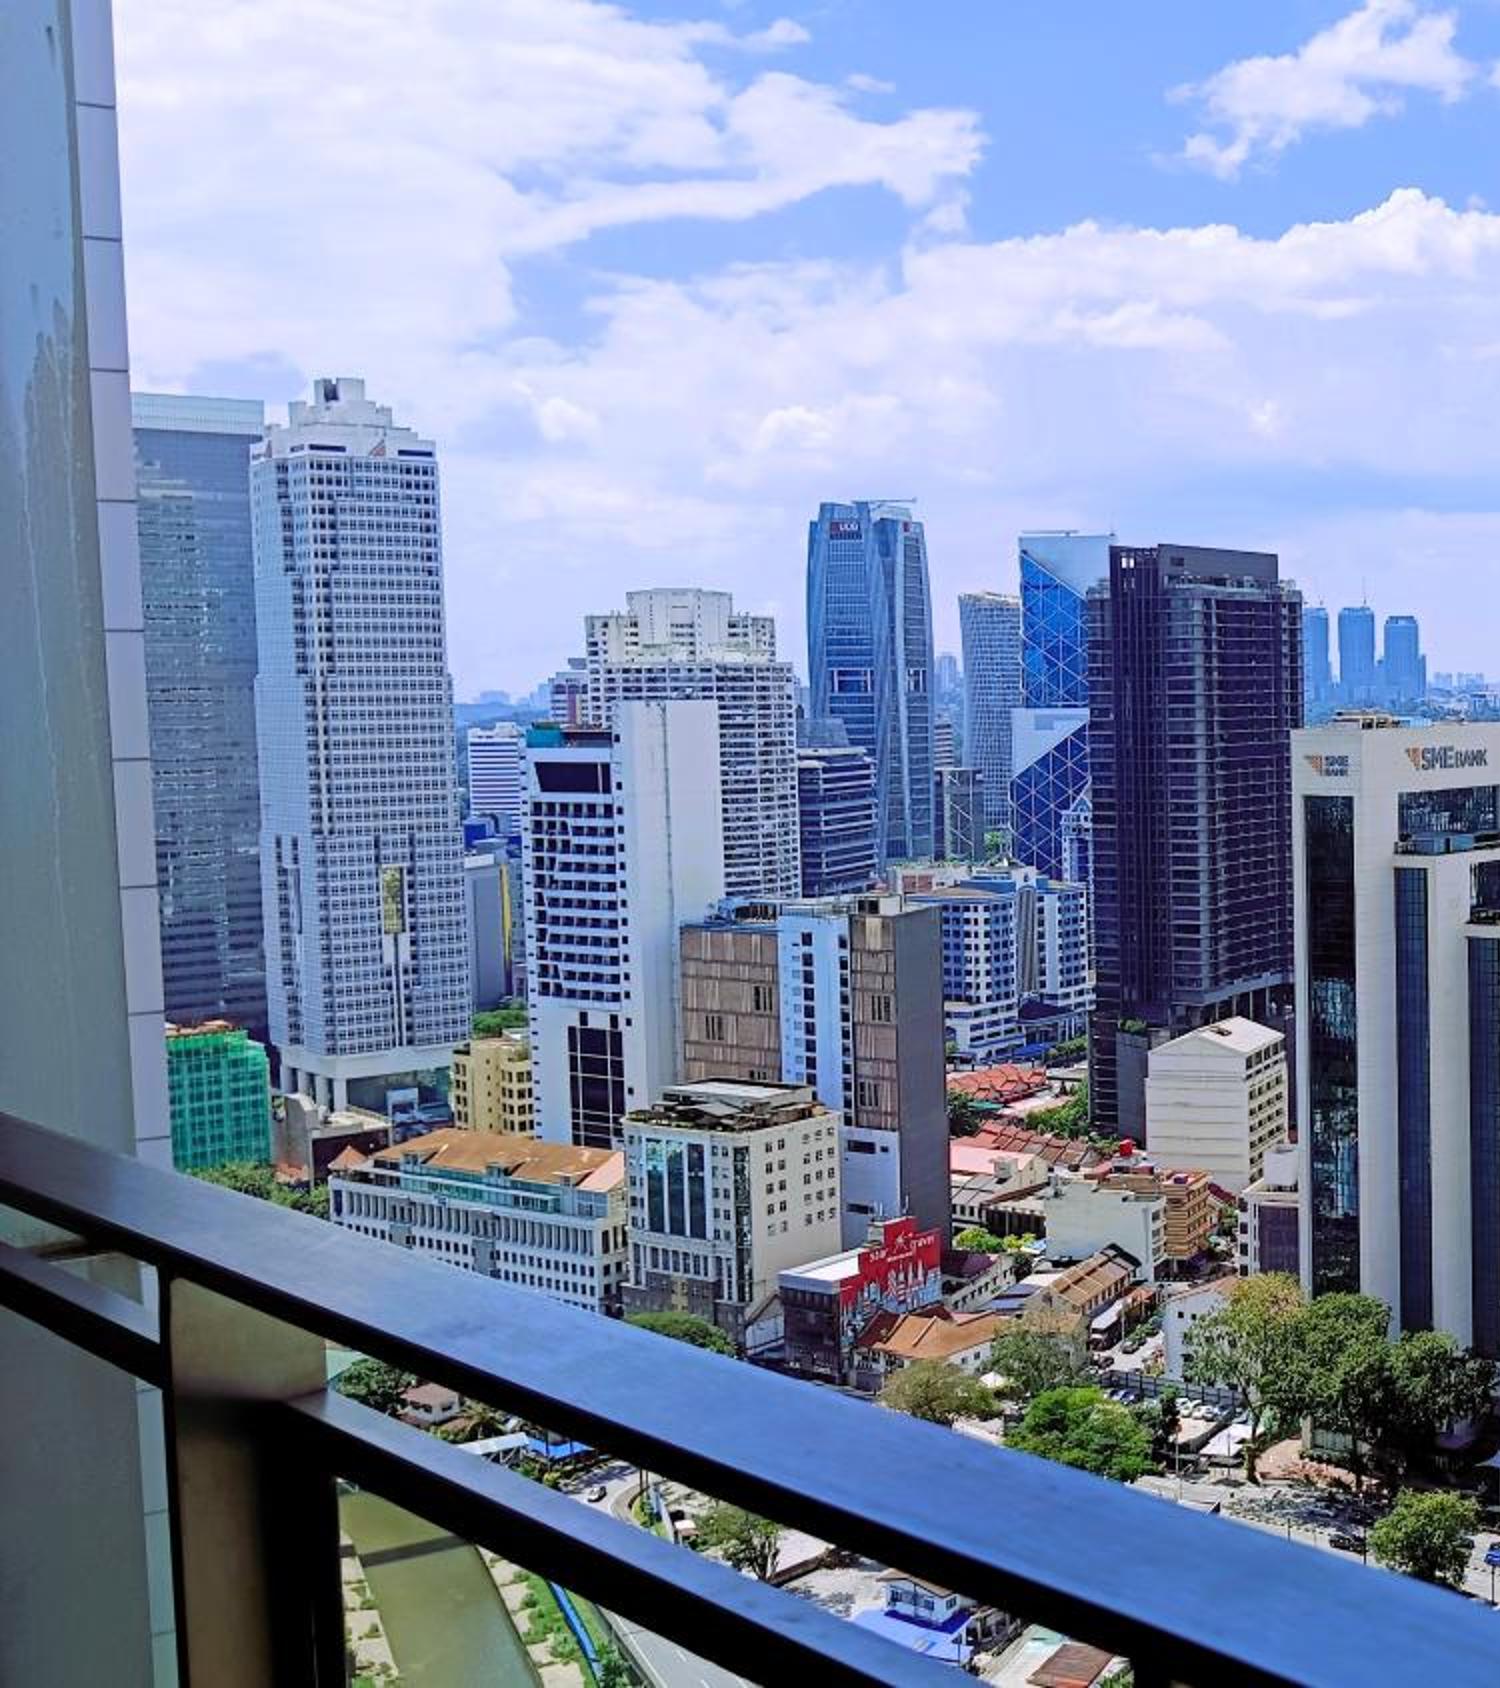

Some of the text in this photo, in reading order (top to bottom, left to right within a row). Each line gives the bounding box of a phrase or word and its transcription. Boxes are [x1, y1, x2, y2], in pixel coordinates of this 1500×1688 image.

[1325, 755, 1349, 767] SME
[1421, 747, 1488, 770] SME BANK
